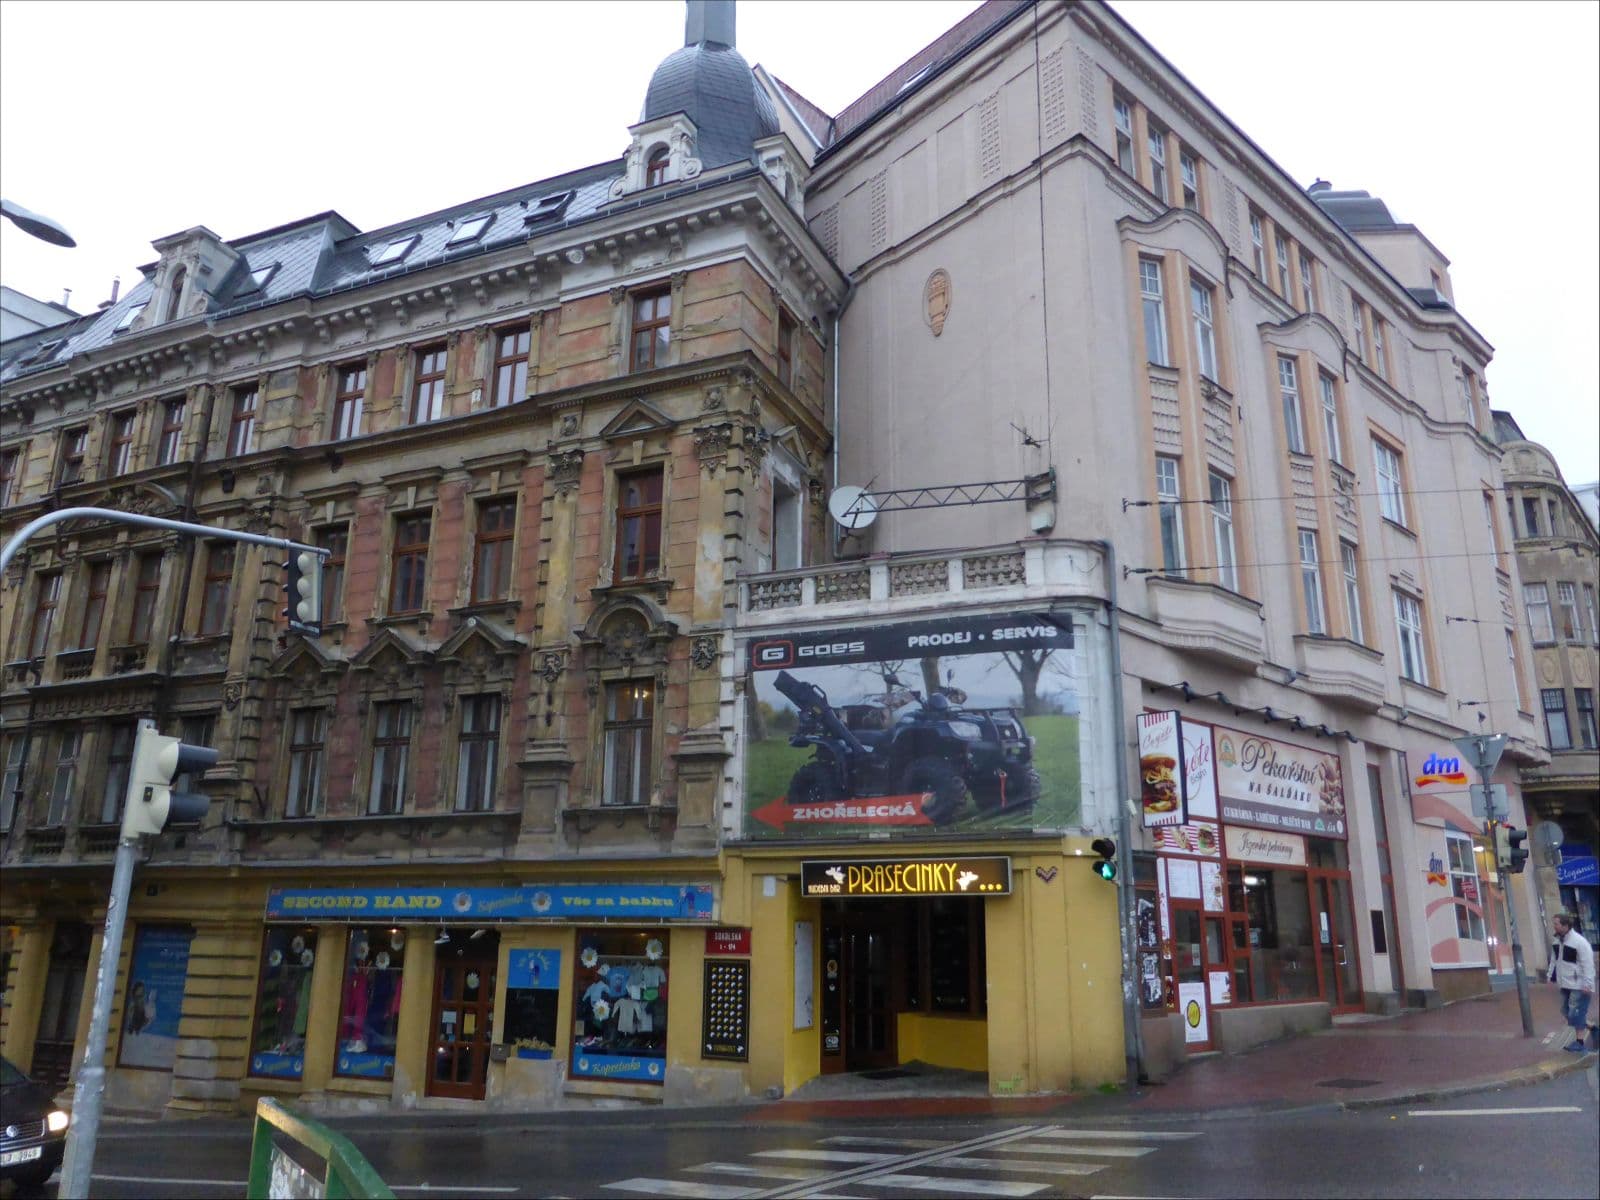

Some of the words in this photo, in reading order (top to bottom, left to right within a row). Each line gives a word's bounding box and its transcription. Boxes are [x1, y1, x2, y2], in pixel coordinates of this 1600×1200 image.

[908, 631, 972, 648] PRODEJ
[992, 625, 1058, 641] SERVIS
[762, 647, 784, 661] G
[798, 641, 865, 657] GOES
[1241, 737, 1318, 785] Pekařství
[1423, 752, 1459, 775] dm
[1248, 781, 1261, 794] NA
[793, 802, 917, 820] ZHOŘELECKÁ
[1429, 851, 1443, 872] dm
[283, 895, 368, 909] SECOND
[374, 895, 442, 909] HAND
[619, 895, 674, 907] babku
